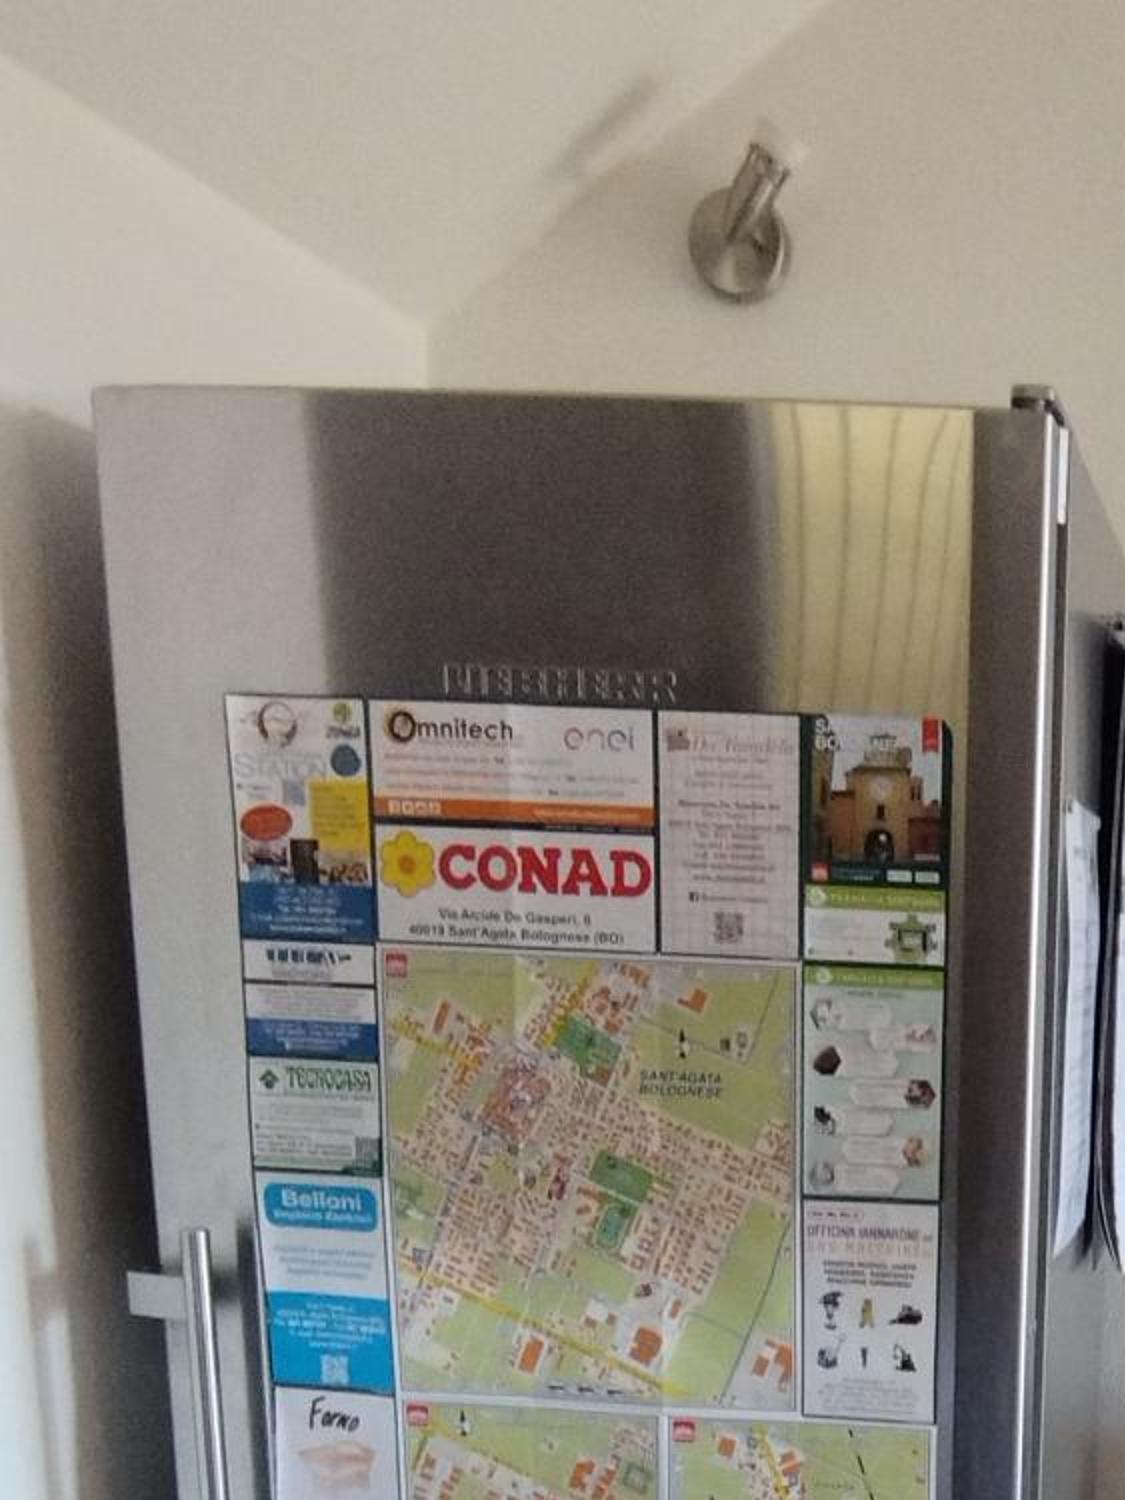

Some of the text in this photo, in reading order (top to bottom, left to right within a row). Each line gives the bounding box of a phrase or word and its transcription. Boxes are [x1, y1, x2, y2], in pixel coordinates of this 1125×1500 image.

[388, 711, 513, 742] Omnitech
[563, 727, 634, 751] enel
[438, 844, 652, 897] CONAD
[438, 908, 459, 922] Via
[504, 909, 522, 924] De
[449, 924, 516, 942] Sant'Agata
[521, 927, 590, 944] Bolognese
[594, 930, 625, 945] (BO)
[286, 1065, 372, 1093] TECNOCASA
[639, 1085, 722, 1098] BOLOGNESE
[309, 1396, 360, 1432] Forno
